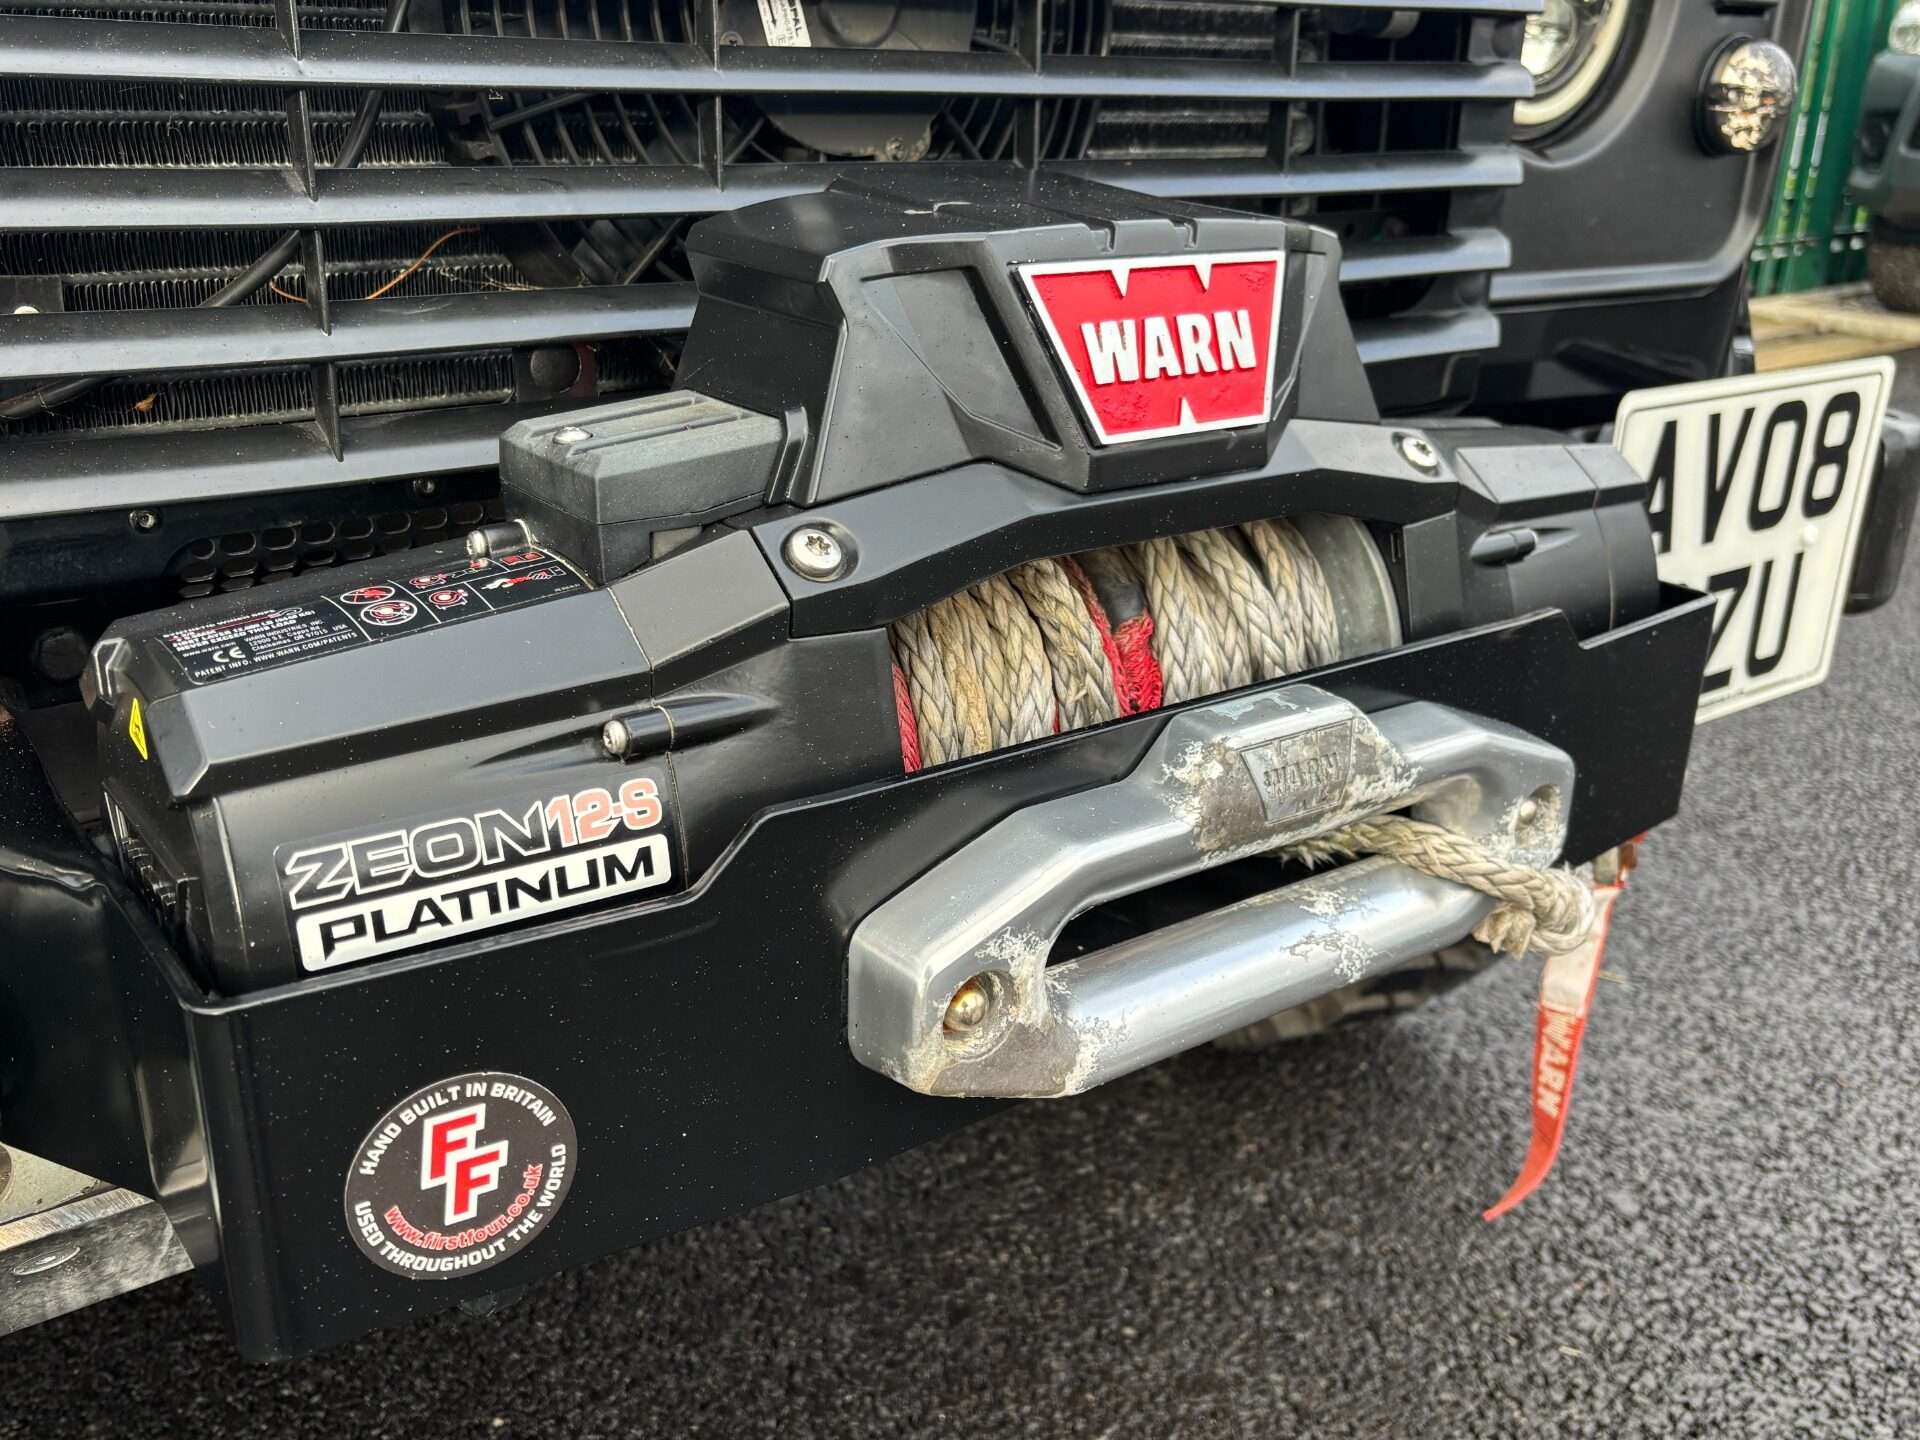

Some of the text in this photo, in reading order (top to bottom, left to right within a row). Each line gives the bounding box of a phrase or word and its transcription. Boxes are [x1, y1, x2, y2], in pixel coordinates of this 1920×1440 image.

[1081, 308, 1257, 385] WARN
[1647, 391, 1861, 554] AV08
[176, 639, 209, 652] NEVER
[210, 631, 247, 644] EXCEED
[247, 625, 271, 635] THIS
[271, 620, 297, 629] LOAD
[244, 633, 266, 642] WARN
[332, 624, 348, 632] USA
[194, 662, 226, 678] PATENT
[318, 845, 656, 961] PLATINUM
[359, 1082, 558, 1176] HAND BUILT IN BRITAIN
[355, 1143, 567, 1272] USED THROUGHOUT THE WORLD
[384, 1162, 543, 1251] www.firstfour.co.uk
